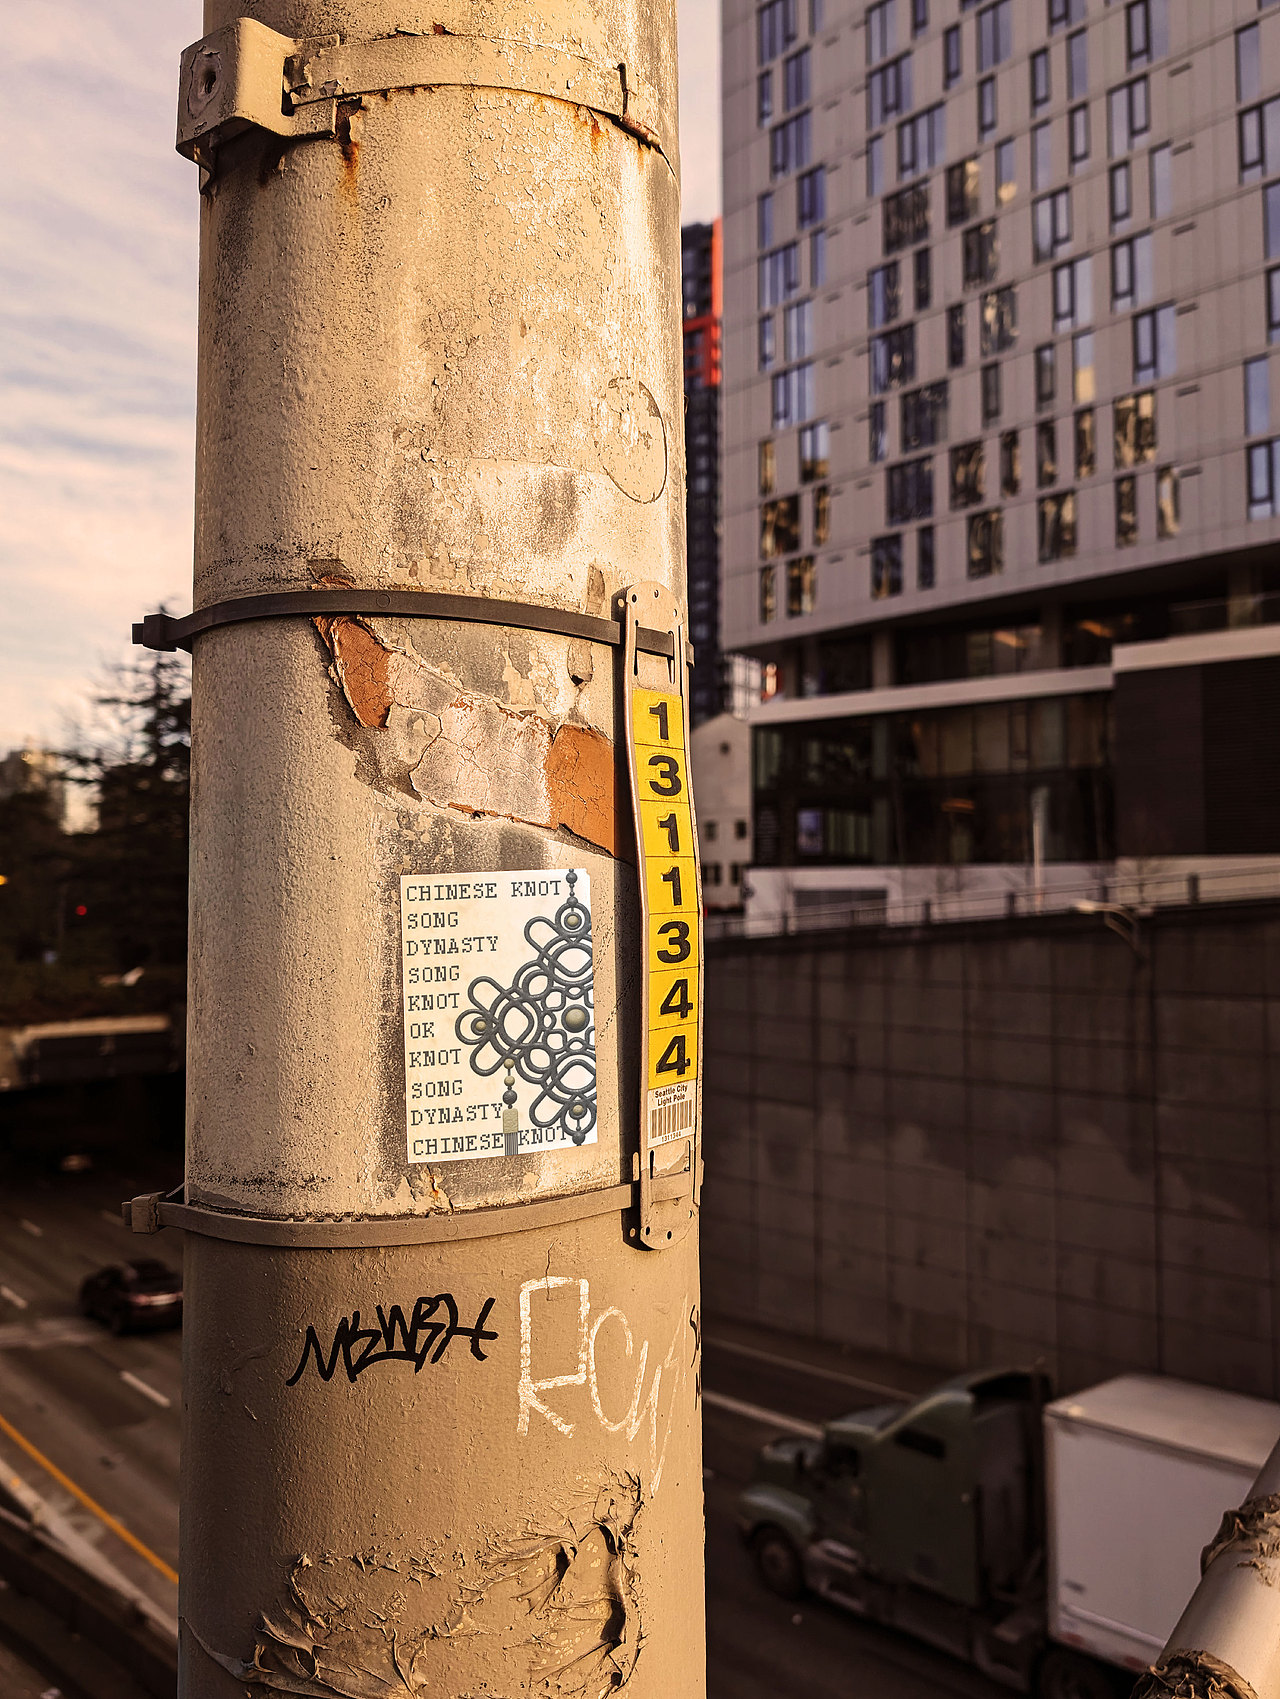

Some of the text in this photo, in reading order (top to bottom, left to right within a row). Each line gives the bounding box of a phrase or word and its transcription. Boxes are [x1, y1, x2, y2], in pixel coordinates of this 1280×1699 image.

[406, 879, 562, 902] CHINESE KNOT
[647, 701, 694, 1076] 1311344
[407, 911, 459, 930] SONG
[406, 935, 499, 957] DYNASTY
[408, 965, 461, 984] SONG
[407, 992, 461, 1012] KNOT
[410, 1021, 436, 1040] OK
[408, 1048, 462, 1068] KNOT
[411, 1079, 464, 1099] SONG
[654, 1084, 688, 1098] Seattle City
[657, 1093, 686, 1106] Light Pole
[410, 1103, 504, 1127] DYNASTY
[412, 1125, 567, 1156] CHINESE KNOT
